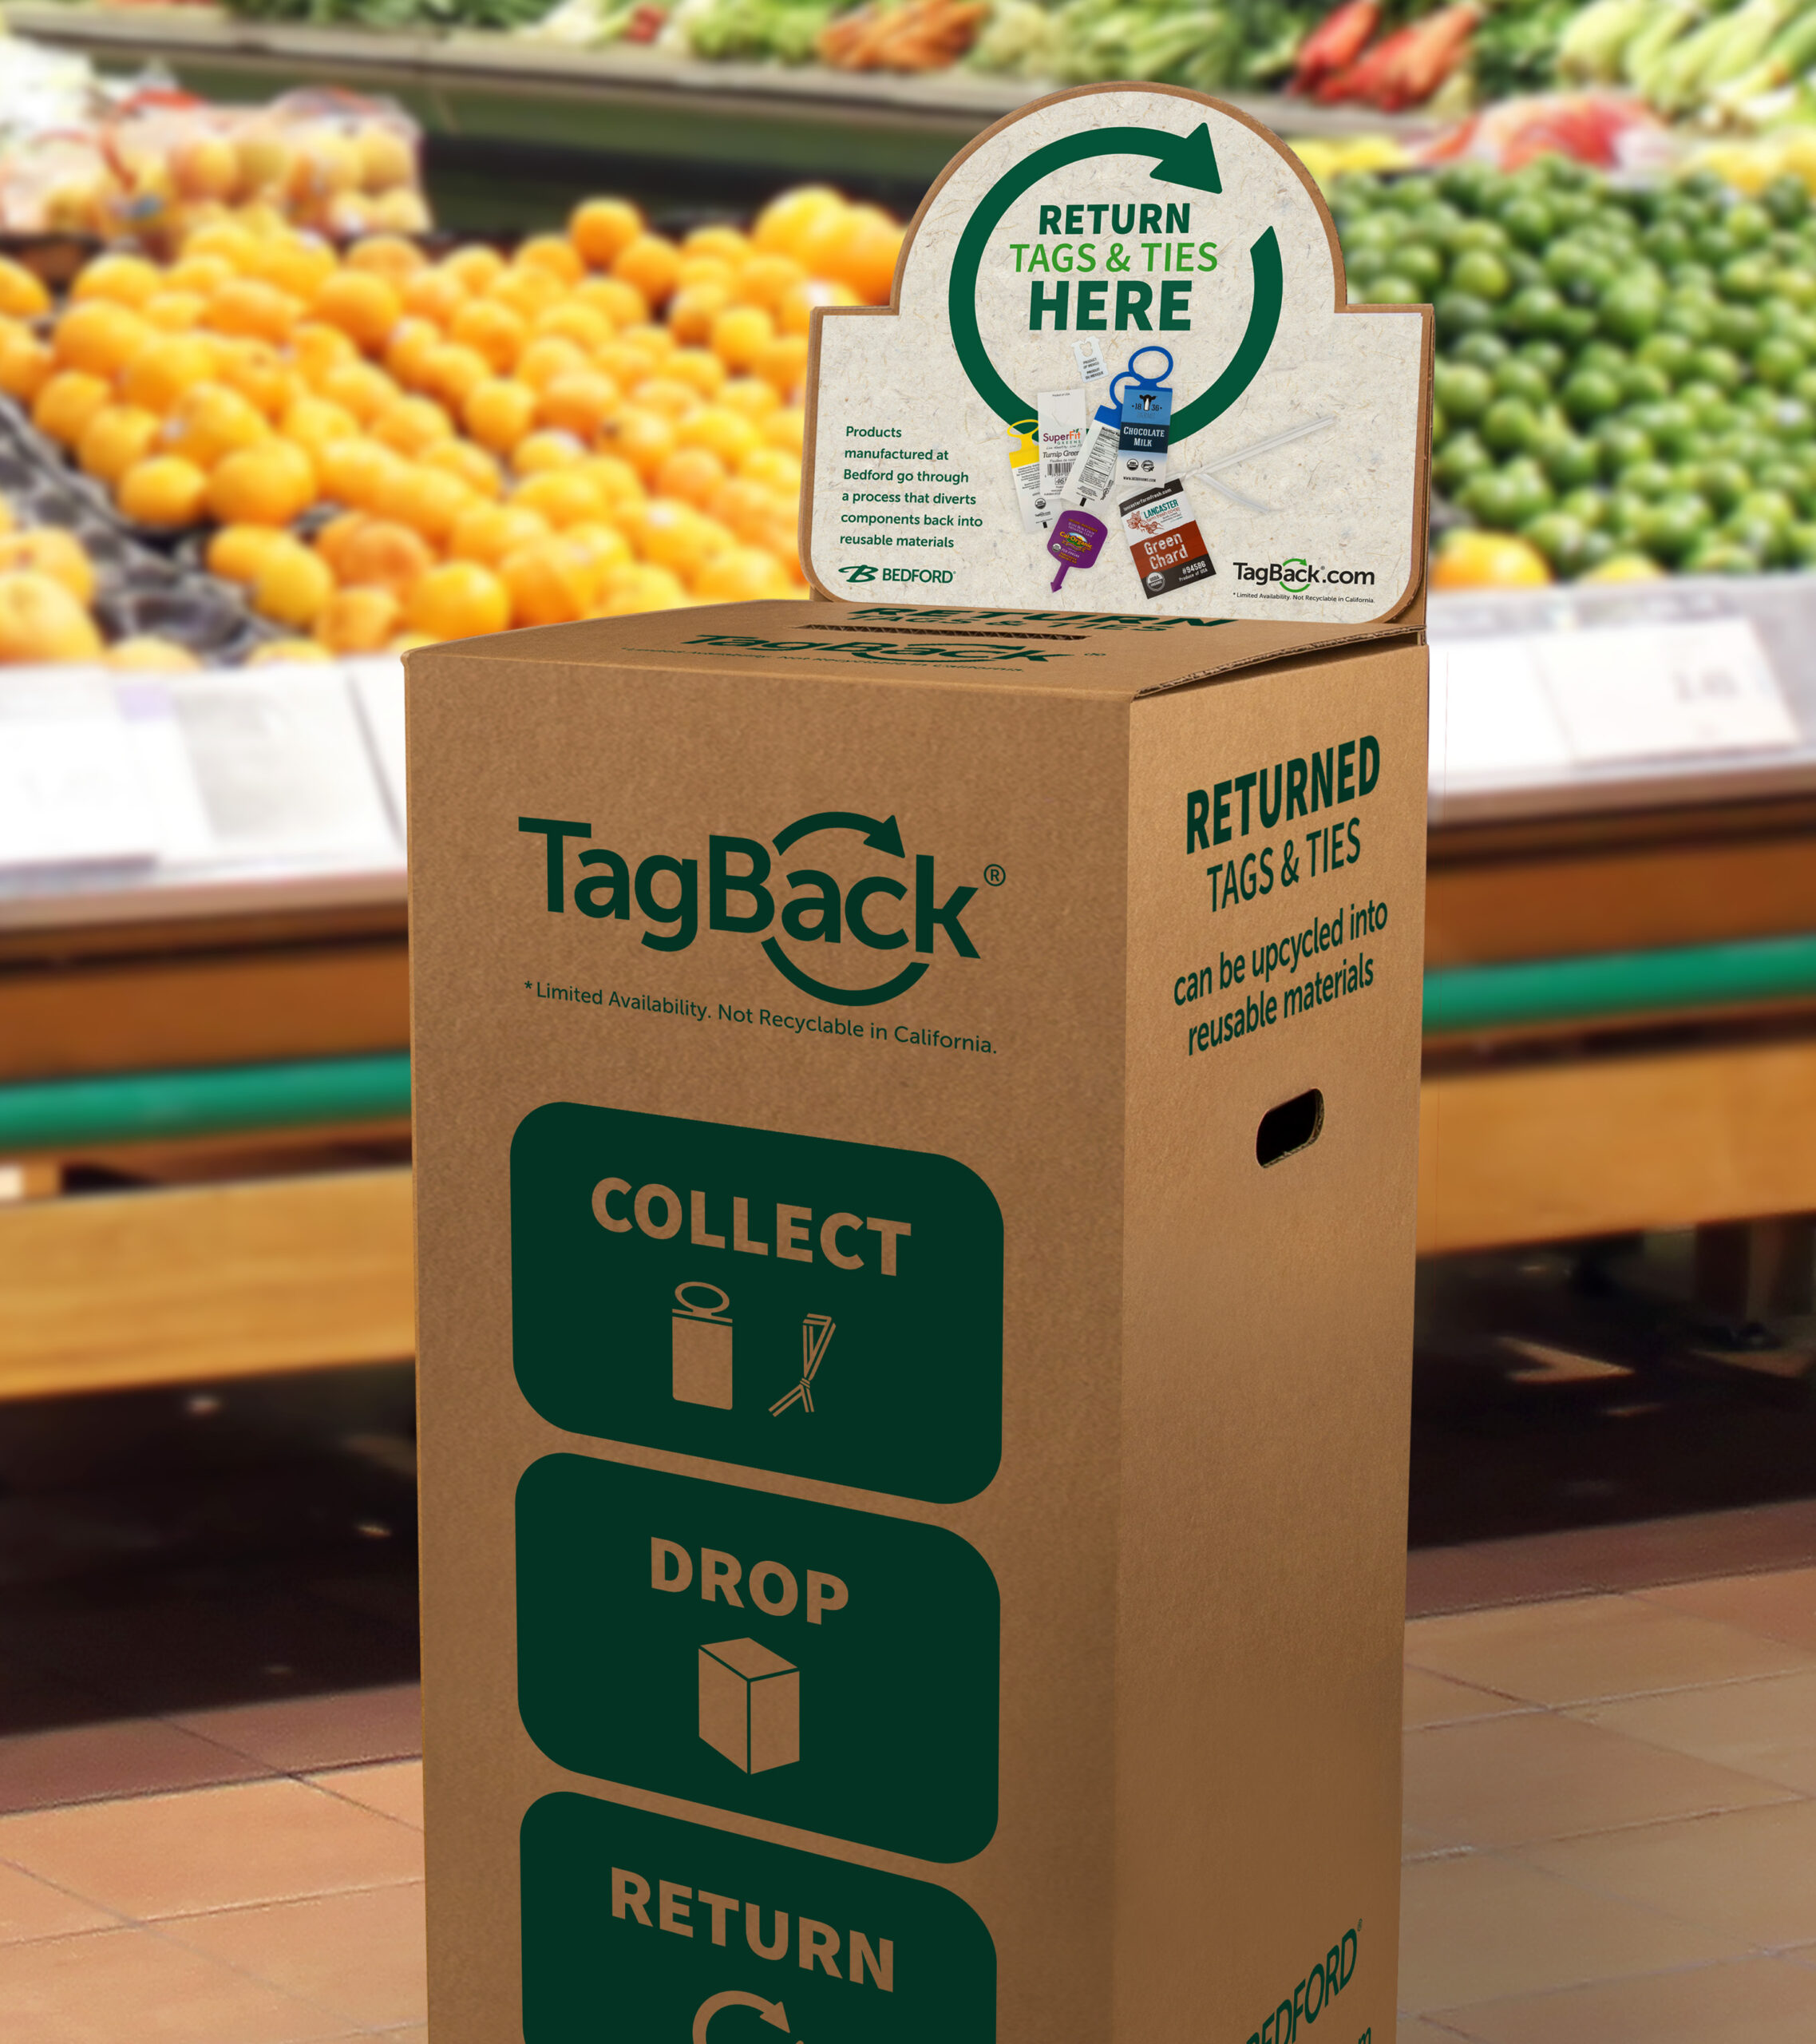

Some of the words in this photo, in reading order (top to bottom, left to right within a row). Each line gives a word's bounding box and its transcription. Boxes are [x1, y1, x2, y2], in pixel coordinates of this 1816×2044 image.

[1039, 203, 1190, 235] RETURN
[1009, 243, 1097, 273] TAGS
[1106, 243, 1131, 272] &
[1141, 241, 1218, 272] TIES
[1029, 279, 1193, 331] HERE
[845, 426, 902, 438] Products
[1043, 430, 1081, 444] SuperFit
[1123, 426, 1165, 438] CHOCOLATE
[1134, 438, 1153, 447] MILK
[844, 448, 933, 461] manufactured
[936, 450, 949, 461] at
[843, 469, 893, 481] Bedford
[896, 472, 914, 484] go
[917, 470, 969, 485] through
[842, 493, 849, 501] a
[853, 493, 901, 504] process
[904, 492, 929, 504] that
[932, 493, 976, 505] diverts
[1143, 499, 1179, 519] LANCASTER
[841, 513, 920, 526] components
[924, 514, 954, 526] back
[957, 515, 983, 527] into
[840, 534, 893, 546] reusable
[896, 536, 955, 548] materials
[1143, 533, 1183, 555] Green
[1149, 545, 1189, 570] Chard
[882, 568, 954, 584] BEDFORD
[847, 615, 979, 624] TAGS
[1046, 622, 1176, 632] TIES
[848, 608, 1239, 627] RETURN
[1186, 735, 1380, 855] RETURNED
[1206, 846, 1275, 913] TAGS
[1281, 839, 1300, 888] &
[1306, 817, 1361, 877] TIES
[1173, 967, 1213, 1006] can
[1219, 951, 1245, 990] be
[1252, 907, 1343, 983] upcycled
[1350, 899, 1388, 941] into
[1188, 989, 1277, 1056] reusable
[1284, 952, 1374, 1019] materials
[608, 991, 711, 1021] Availability.
[718, 1004, 754, 1024] Not
[759, 1008, 864, 1037] Recyclable
[870, 1023, 888, 1040] in
[894, 1025, 997, 1054] California.
[591, 1176, 912, 1278] COLLECT
[651, 1536, 849, 1626] DROP
[611, 1867, 894, 1994] RETURN
